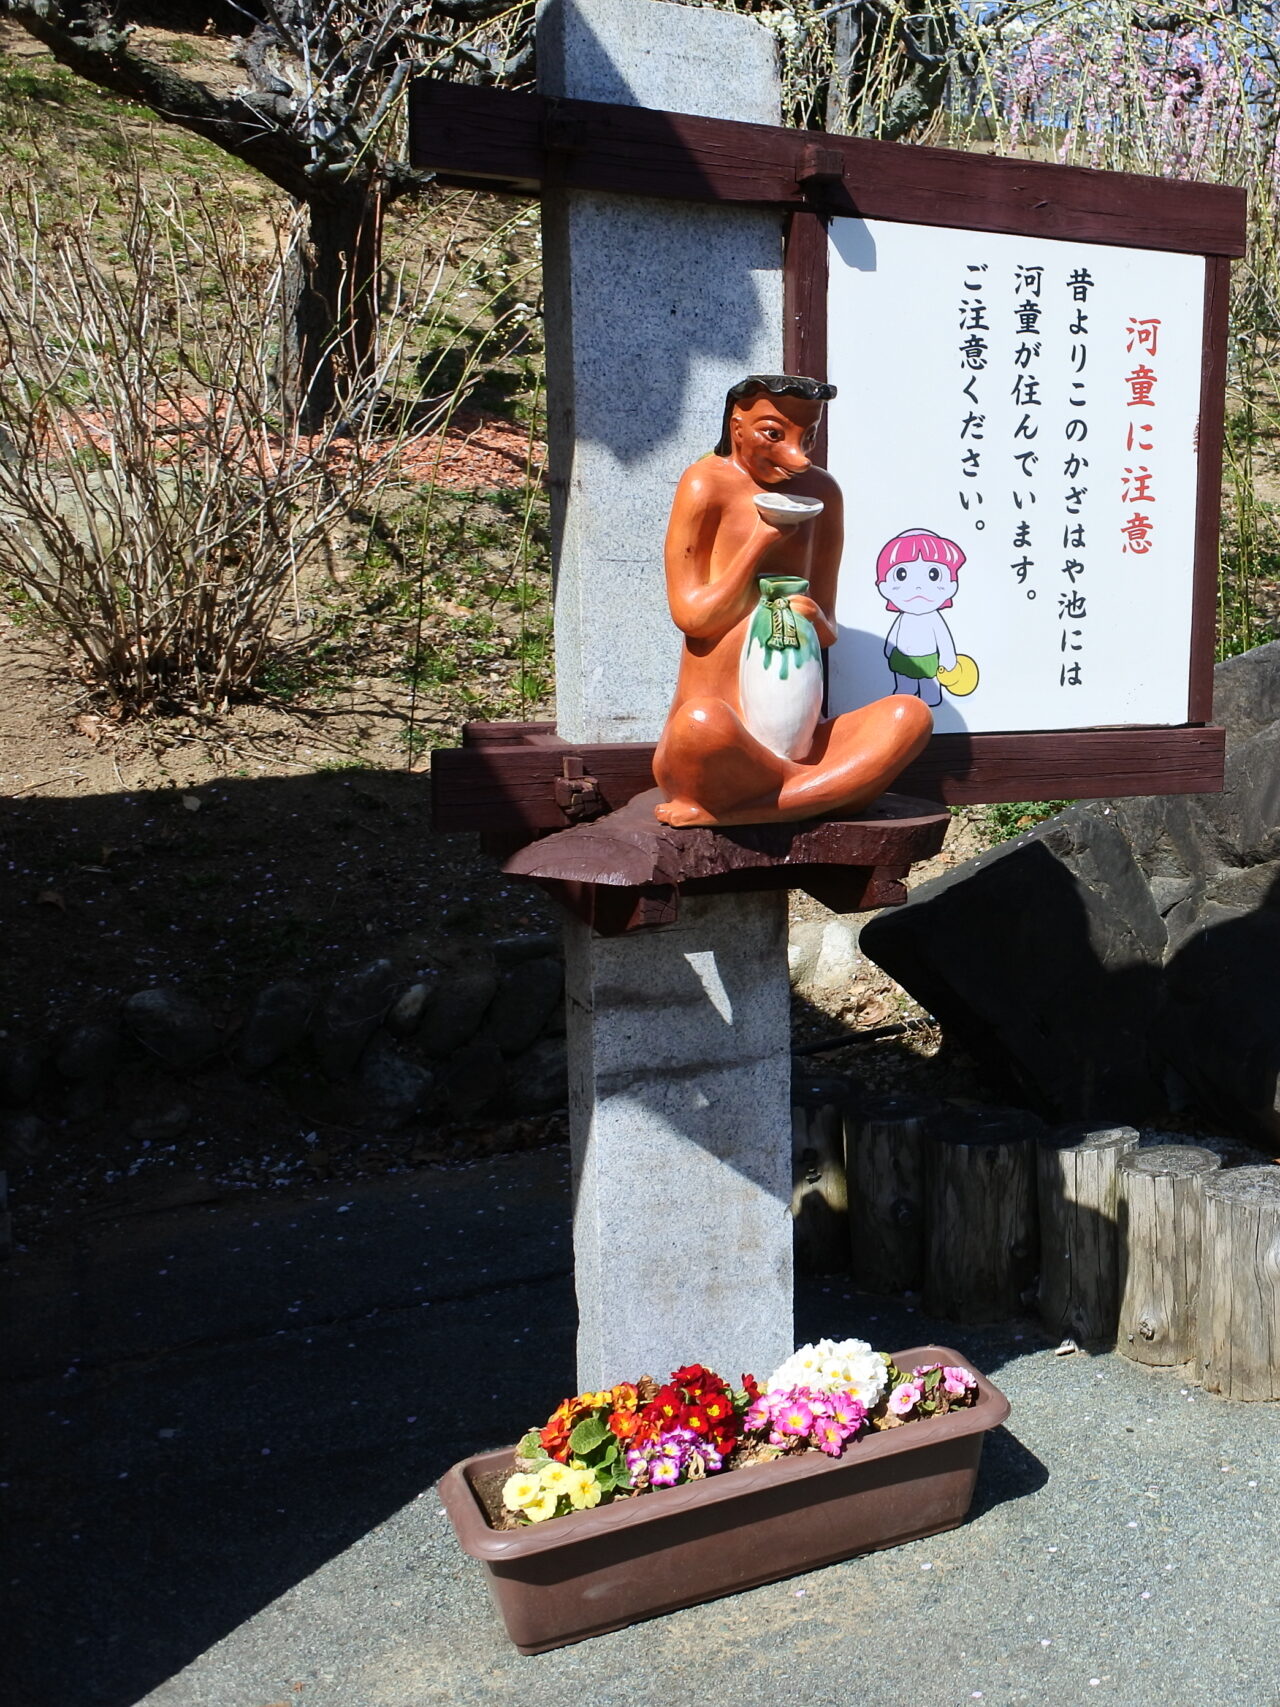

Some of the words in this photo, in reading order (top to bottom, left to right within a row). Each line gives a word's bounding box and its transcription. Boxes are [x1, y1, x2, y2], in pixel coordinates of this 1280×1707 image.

[957, 263, 991, 532] ご注意ください。
[1010, 264, 1045, 601] 河童が住んでいます。
[1057, 268, 1095, 687] 昔よりこのかざはや池には
[1120, 317, 1162, 554] 河童に注意
